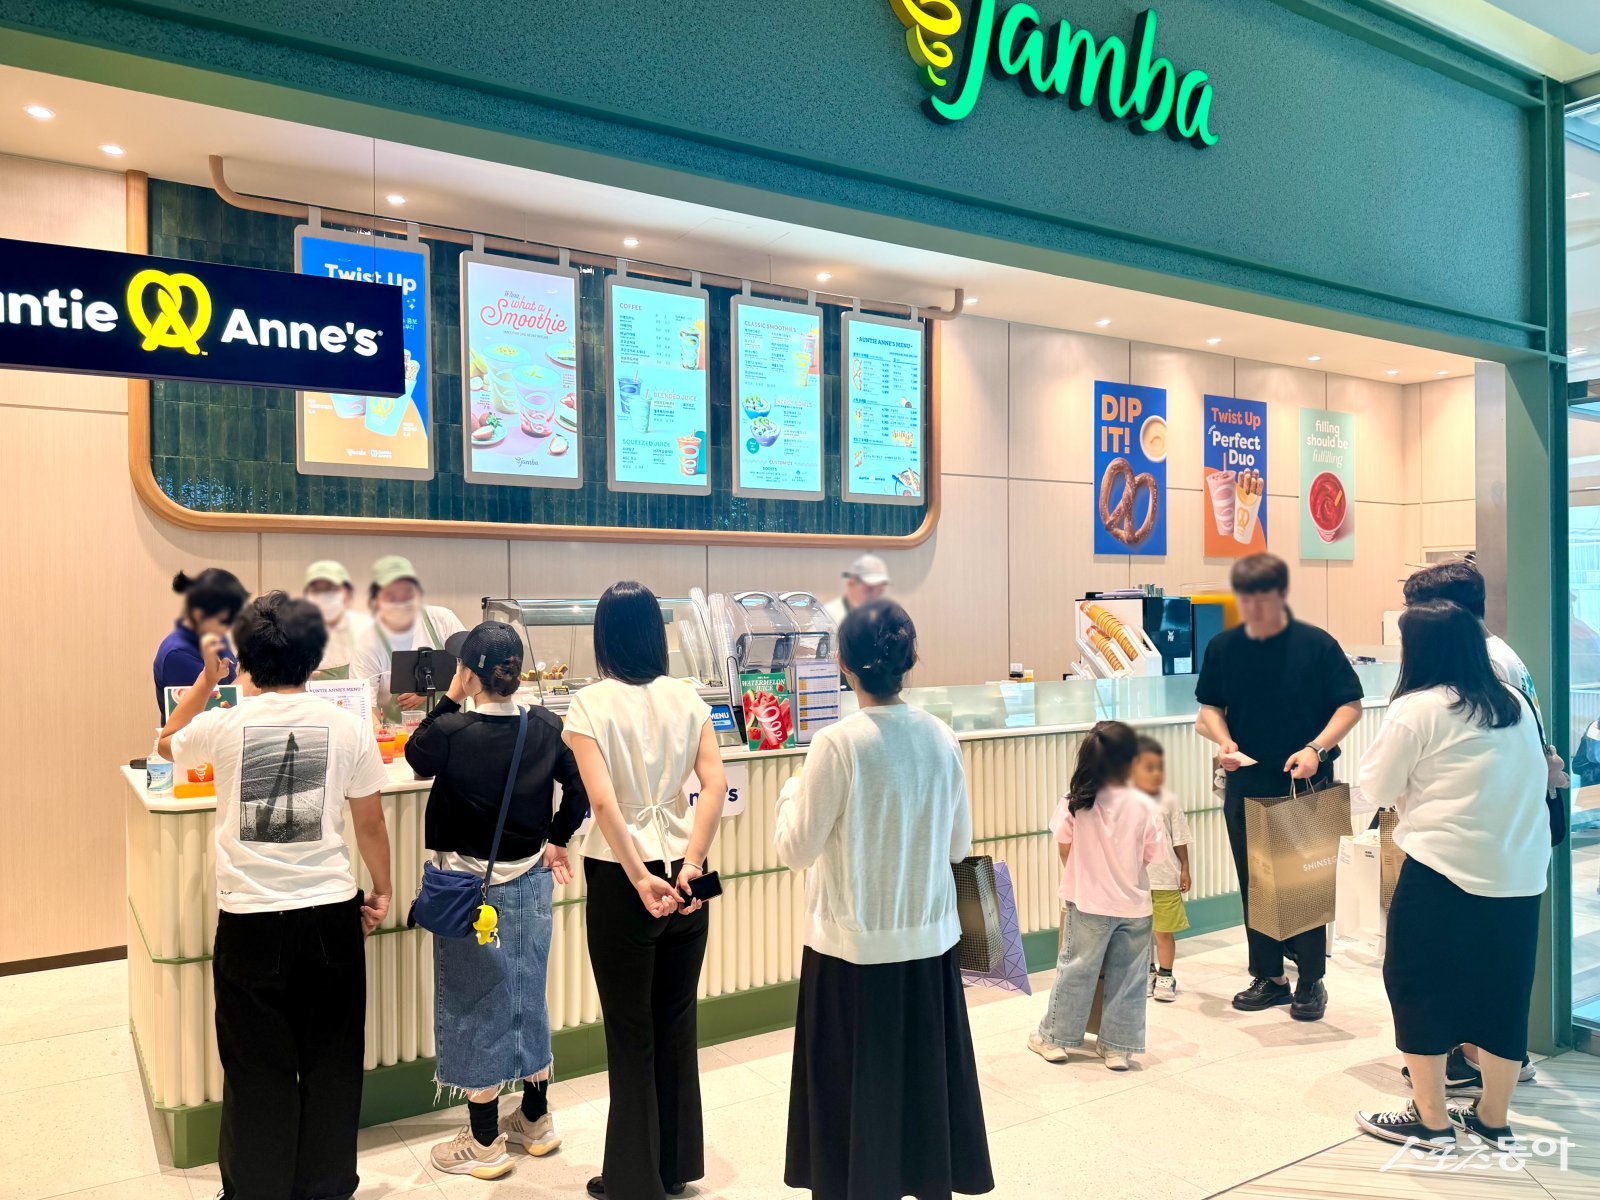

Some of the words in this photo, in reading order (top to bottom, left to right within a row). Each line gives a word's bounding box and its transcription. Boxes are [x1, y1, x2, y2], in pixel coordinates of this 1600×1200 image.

[387, 272, 417, 295] Up
[510, 296, 536, 311] what
[537, 304, 545, 312] a
[619, 302, 643, 311] COFFEE
[0, 288, 118, 333] ntie
[220, 308, 379, 357] Anne's
[480, 298, 568, 335] Smoothie
[744, 320, 766, 329] CLASSIC
[766, 323, 797, 333] SMOOTHIES
[858, 336, 878, 345] AUNTIE
[878, 339, 896, 347] ANNE'S
[653, 392, 681, 400] BLENDED
[680, 394, 697, 402] JUICE
[1101, 394, 1142, 424] DIP
[1211, 407, 1243, 426] Twist
[1244, 411, 1261, 431] Up
[1315, 419, 1340, 438] filling
[622, 439, 654, 447] SQUEEZED
[653, 440, 671, 448] JUICE
[1101, 425, 1130, 454] IT!
[1212, 430, 1261, 451] Perfect
[1306, 433, 1336, 448] should
[1337, 436, 1349, 449] be
[1228, 449, 1255, 467] Duo
[741, 678, 786, 687] WATERMELON
[711, 712, 730, 720] MENU
